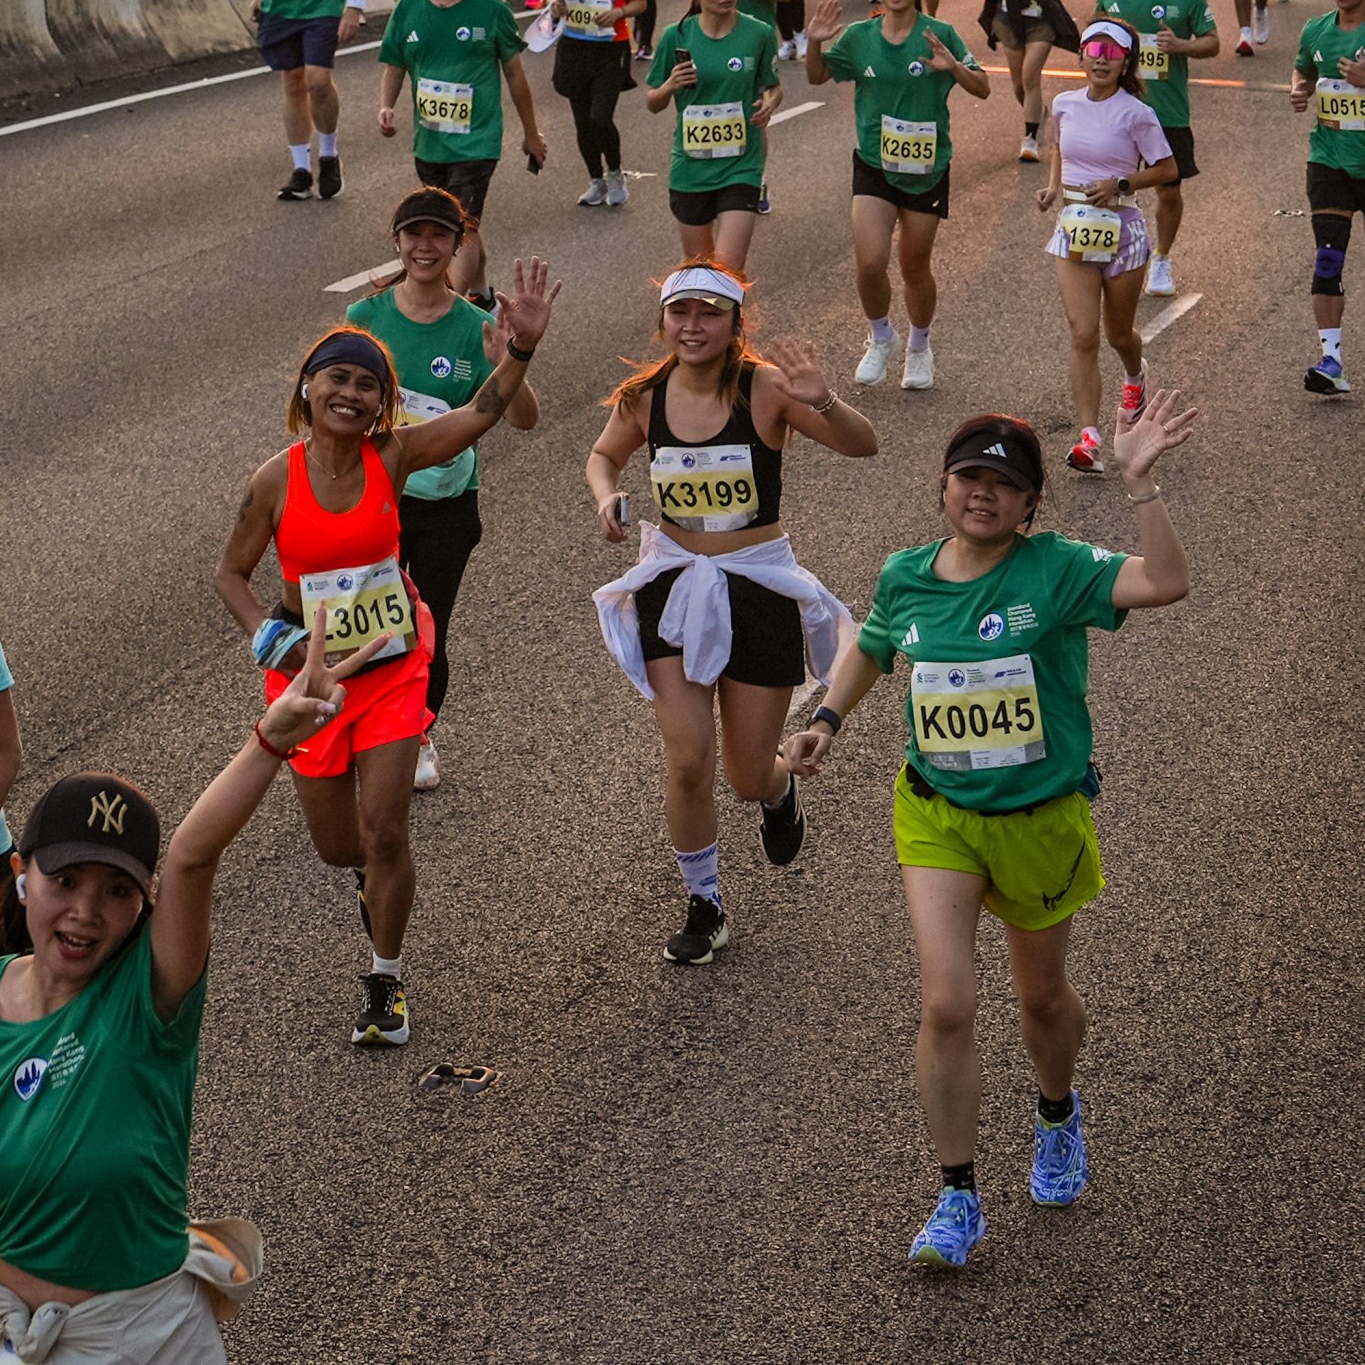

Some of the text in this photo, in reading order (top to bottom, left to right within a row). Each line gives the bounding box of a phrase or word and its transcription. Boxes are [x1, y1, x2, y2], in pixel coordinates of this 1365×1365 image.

[418, 96, 469, 120] K3678
[687, 123, 744, 144] K2633
[882, 136, 933, 159] K2635
[1069, 227, 1115, 248] 1378
[657, 479, 751, 508] K3199
[920, 697, 1035, 740] K0045
[87, 790, 128, 835] NY
